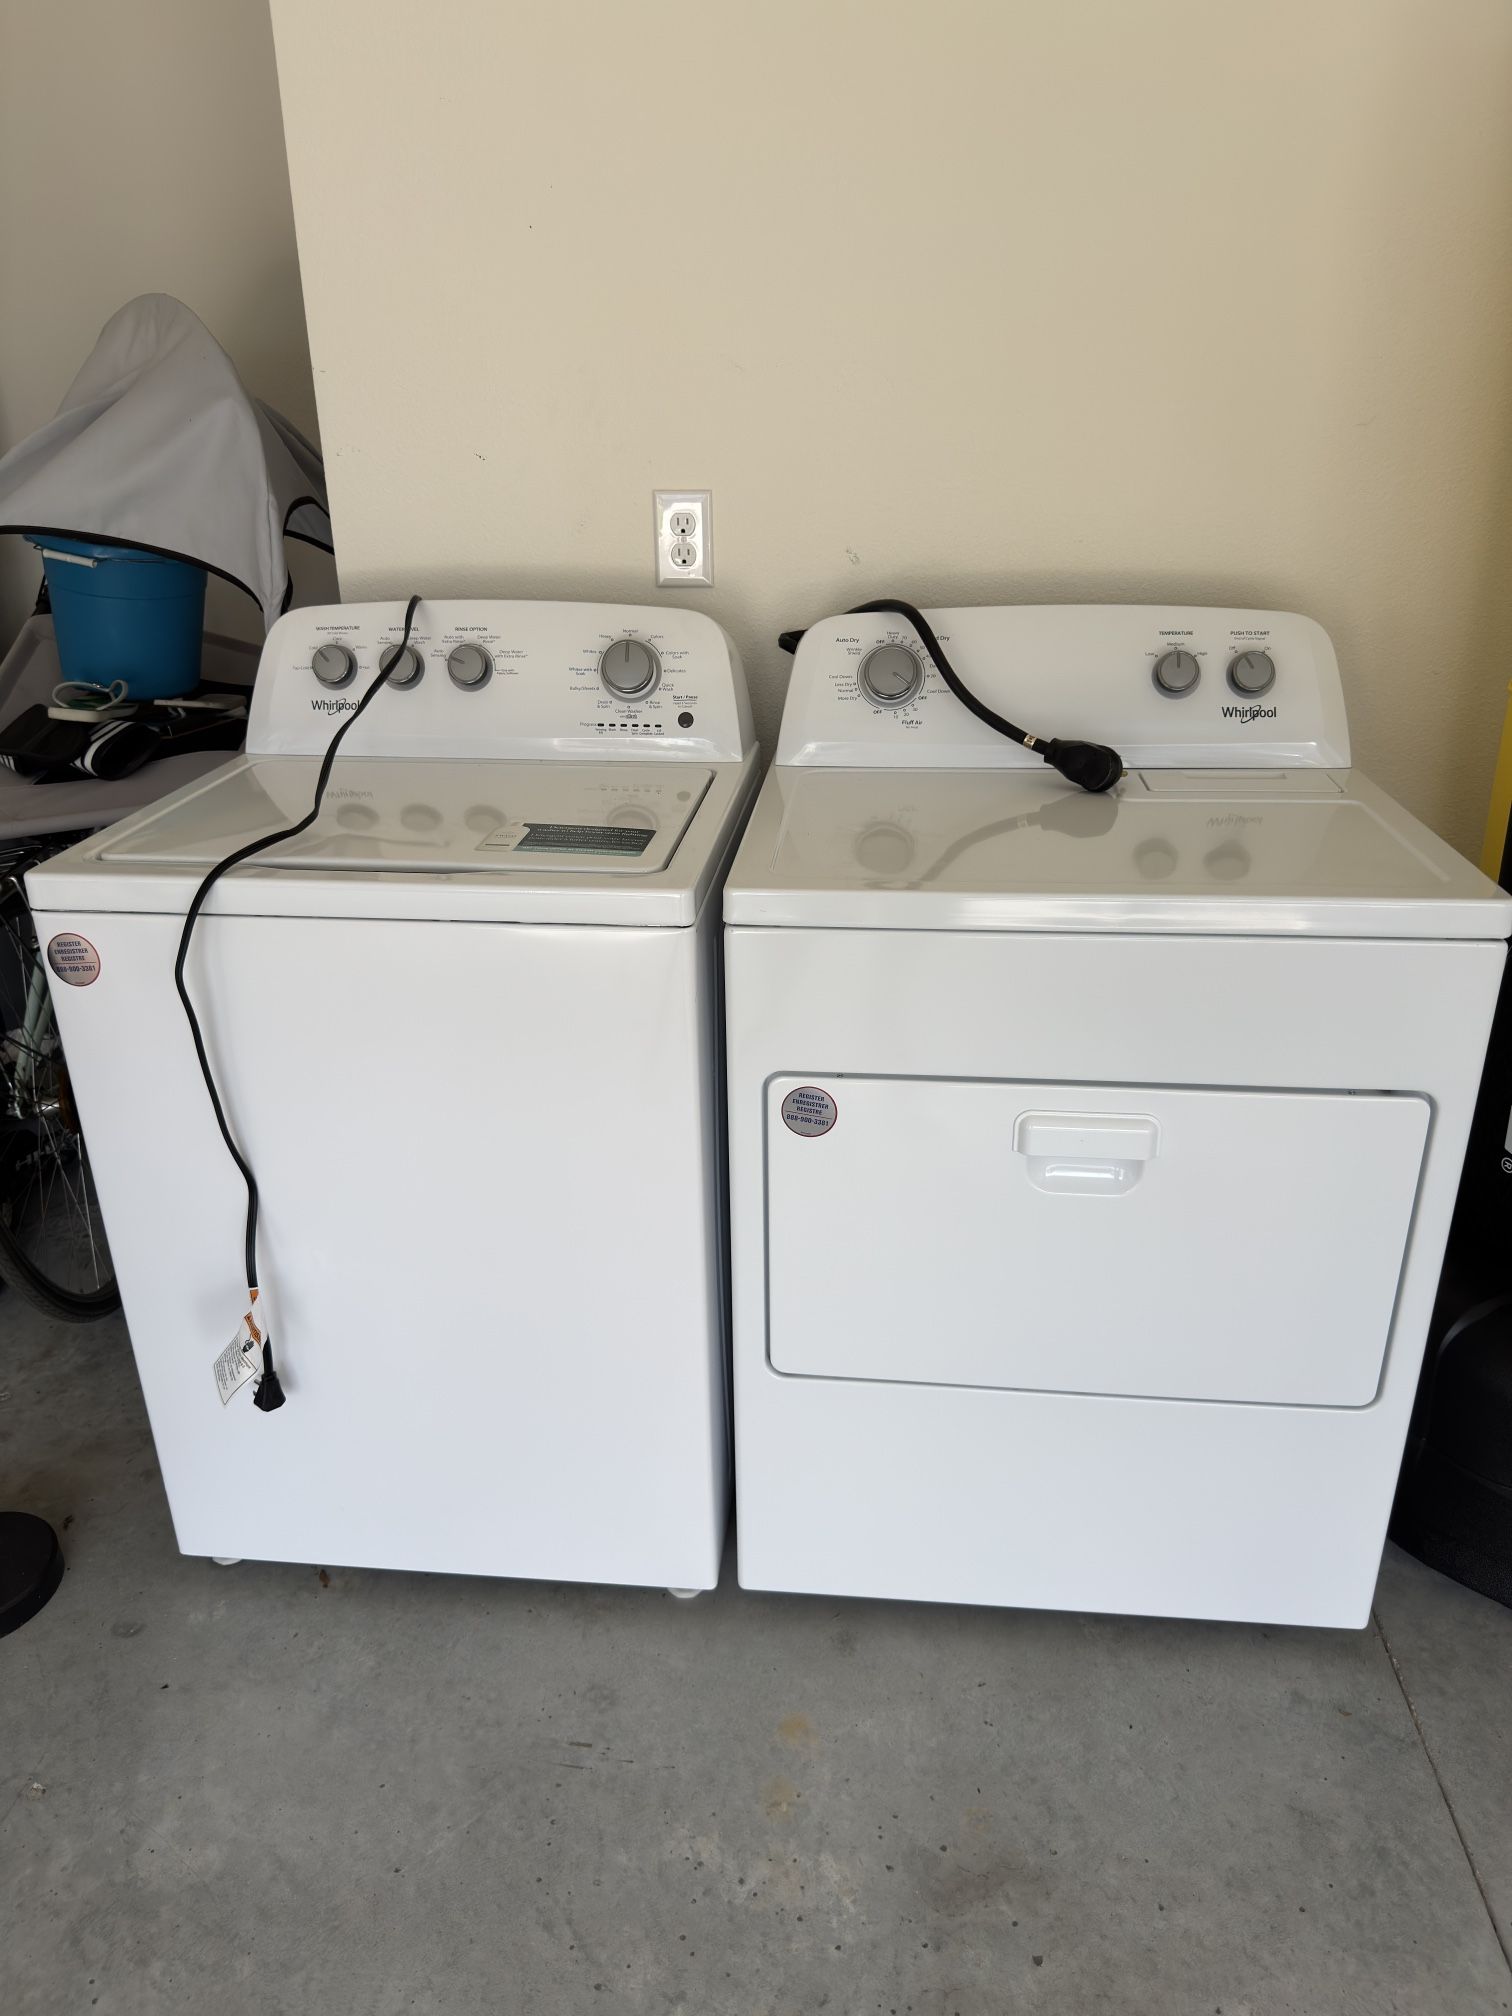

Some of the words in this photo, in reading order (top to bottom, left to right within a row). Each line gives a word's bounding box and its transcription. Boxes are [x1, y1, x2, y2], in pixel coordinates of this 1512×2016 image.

[311, 699, 360, 714] Whirlpool
[1222, 705, 1277, 723] Whirlpool
[799, 1092, 824, 1101] REGISTER
[792, 1099, 828, 1109] ENREGISTRER
[796, 1106, 822, 1115] REGISTRE
